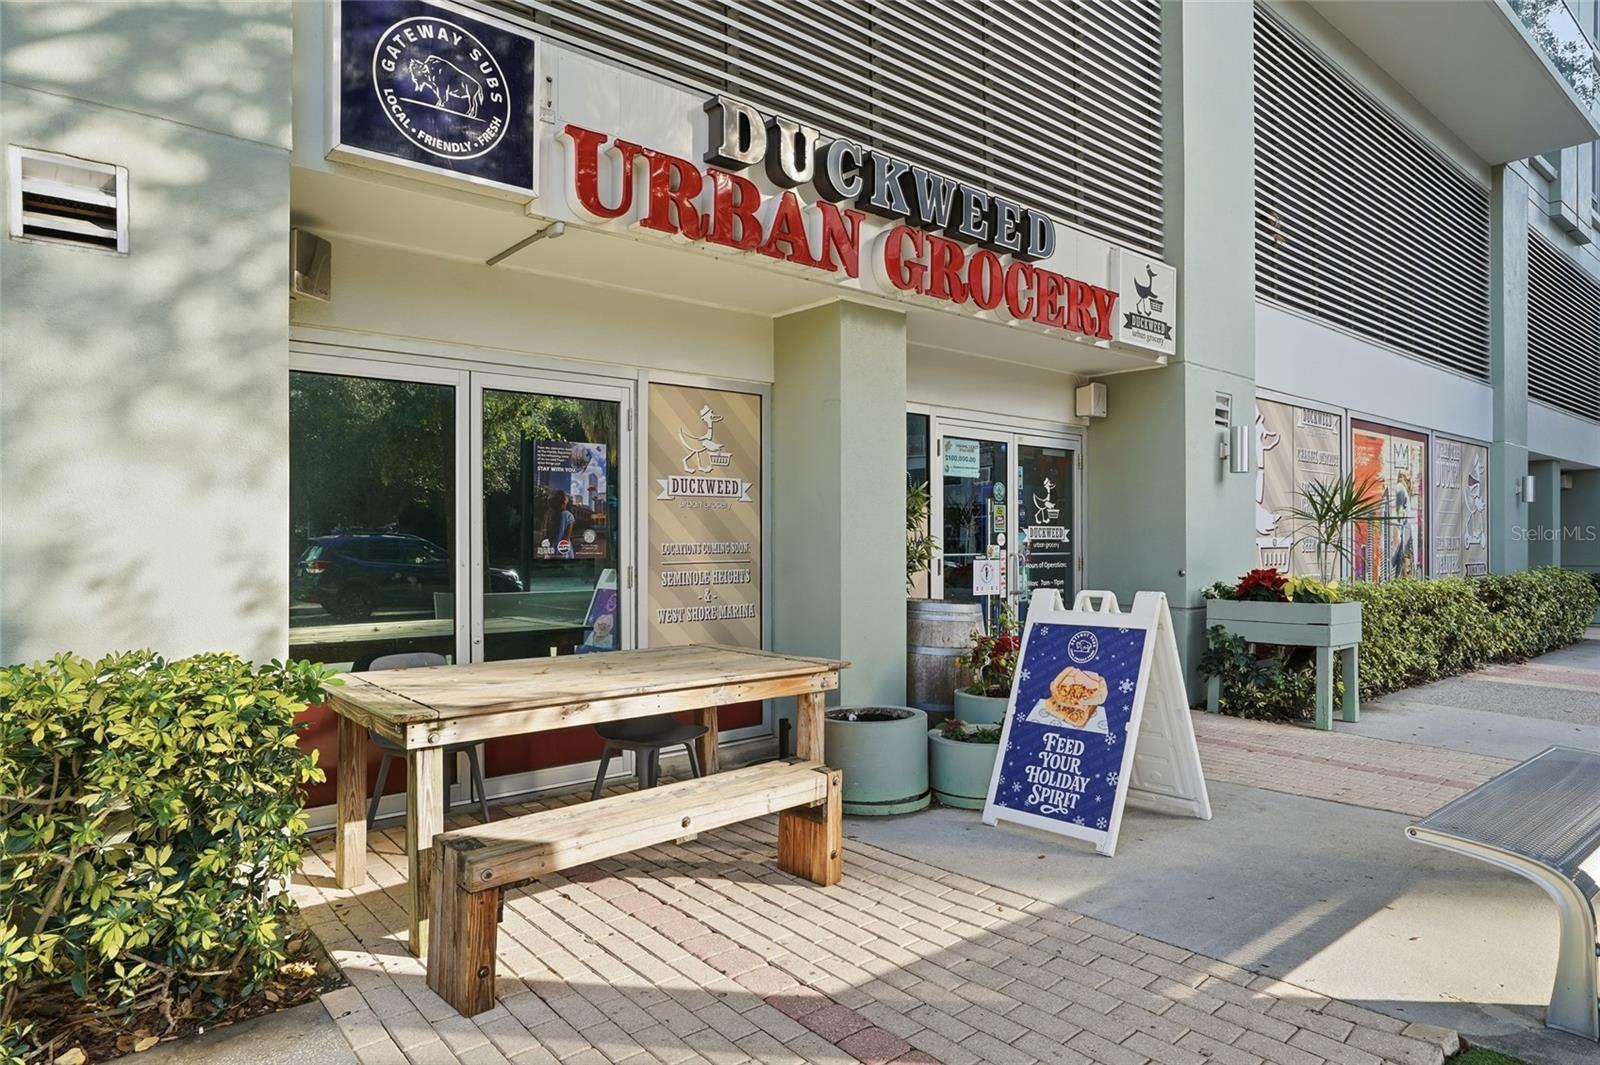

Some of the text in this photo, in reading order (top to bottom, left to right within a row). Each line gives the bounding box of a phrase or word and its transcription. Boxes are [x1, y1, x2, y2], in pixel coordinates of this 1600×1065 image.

[381, 24, 503, 103] GATEWAY SUBS
[383, 88, 502, 153] LOCAL FRIENDLY FRESH
[704, 94, 1056, 262] DUCKWEED
[564, 123, 1119, 341] URBAN GROCERY
[1132, 315, 1165, 334] DUCKWEED
[671, 477, 739, 495] DUCKWEED
[1029, 527, 1064, 538] DUCKWEED
[661, 543, 702, 555] LOCATIONS
[703, 542, 731, 555] COMING
[661, 569, 751, 587] SEMINOLE HEIGHTS
[657, 604, 755, 624] WEST SHORE MARINA
[1042, 731, 1085, 757] FEED
[1038, 751, 1082, 776] YOUR
[1025, 765, 1090, 794] HOLIDAY
[1028, 784, 1081, 815] SPIRIT
